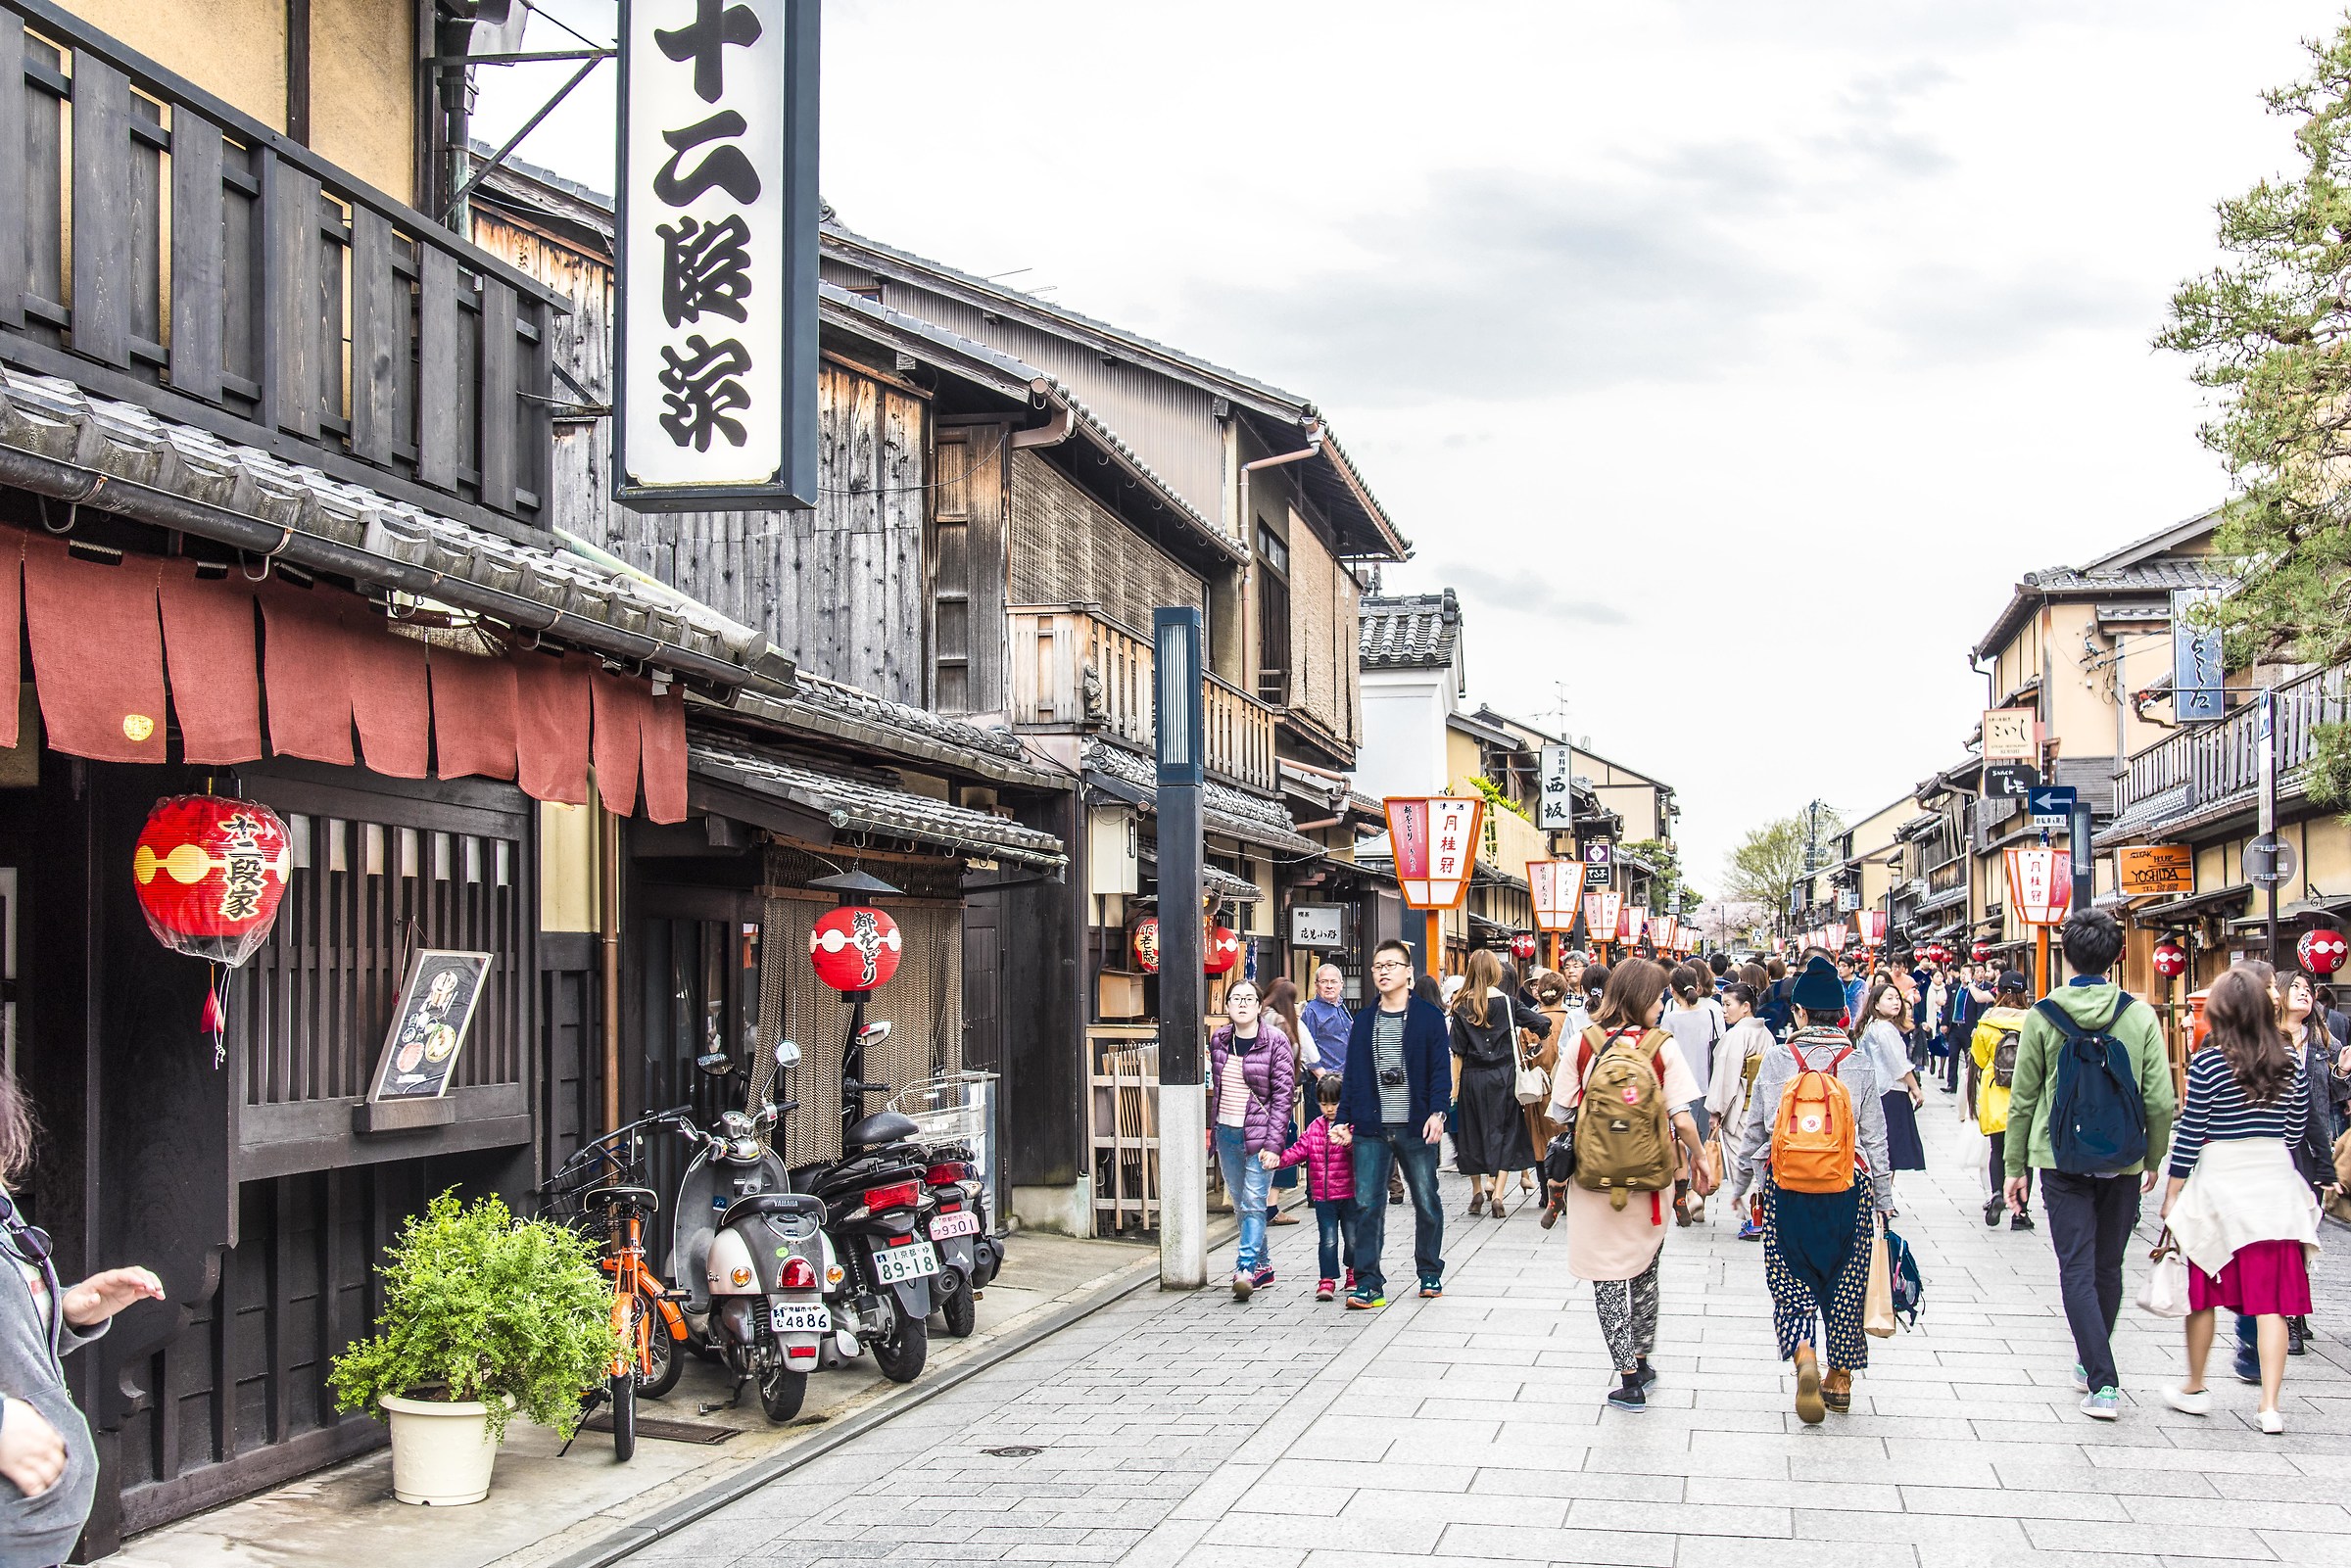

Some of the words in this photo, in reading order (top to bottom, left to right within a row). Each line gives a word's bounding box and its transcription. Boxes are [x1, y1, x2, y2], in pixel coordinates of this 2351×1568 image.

[1993, 718, 2027, 742] こいし
[1558, 749, 1566, 775] 京料理
[1544, 776, 1567, 820] 西坂
[1439, 814, 1458, 874] 月桂冠
[222, 814, 264, 919] 十二段家
[2131, 868, 2180, 883] YOSHIDA
[1300, 927, 1338, 942] 花見小路
[853, 911, 881, 986] 都をどり
[883, 1211, 905, 1219] HONDA
[941, 1218, 974, 1236] 9301
[881, 1256, 935, 1281] 89-18
[786, 1313, 827, 1328] 4886
